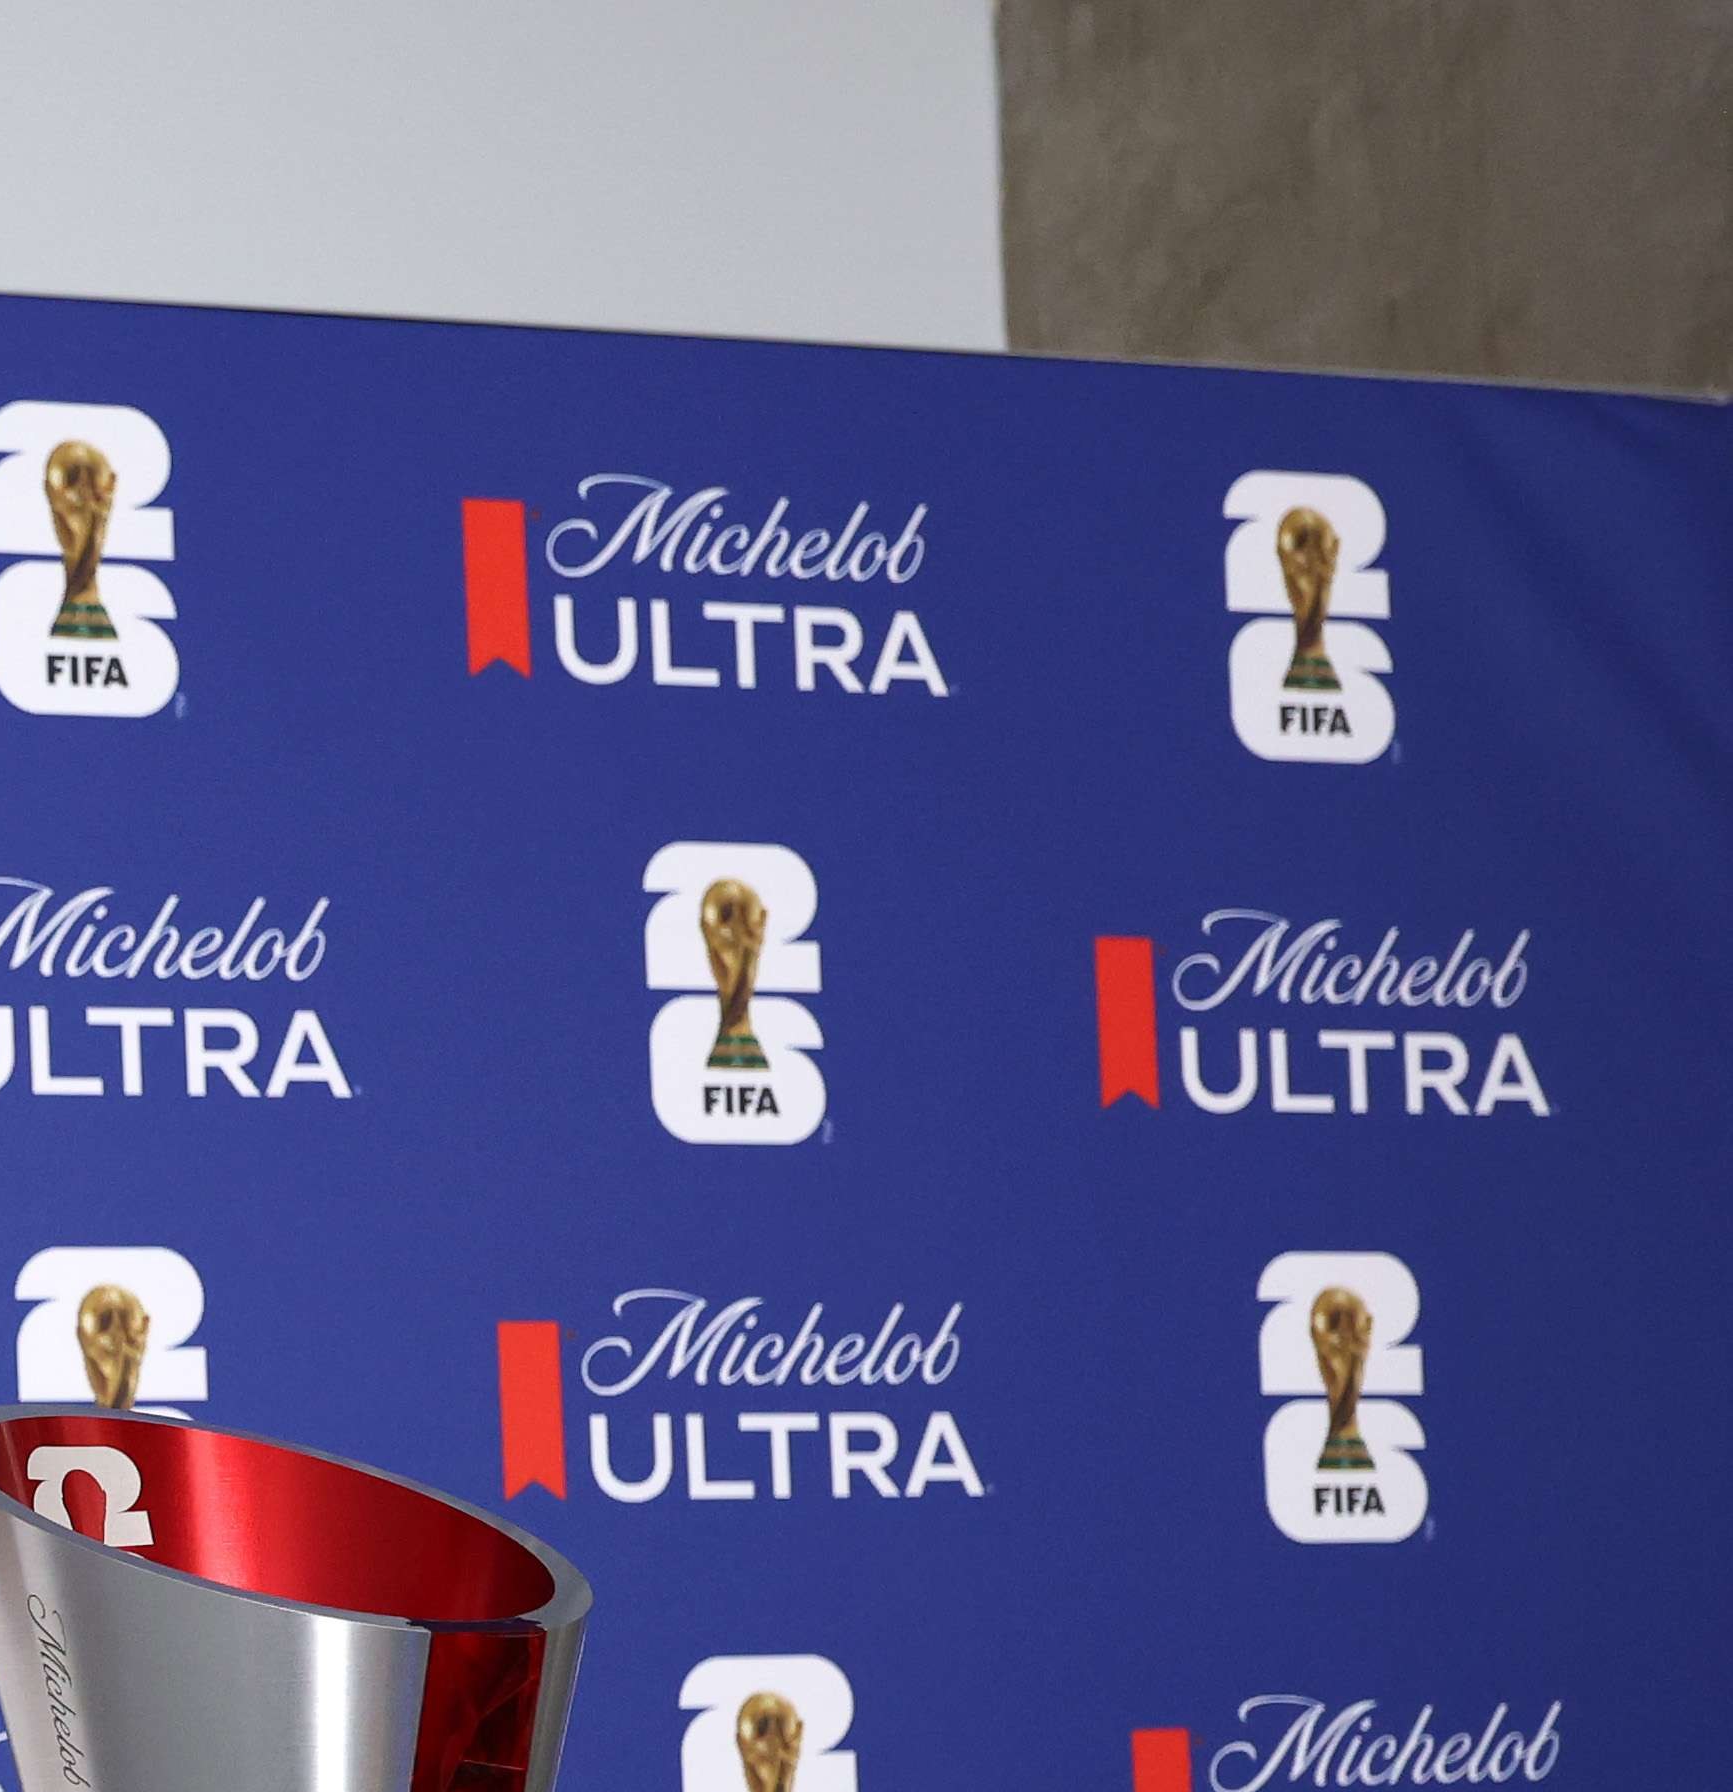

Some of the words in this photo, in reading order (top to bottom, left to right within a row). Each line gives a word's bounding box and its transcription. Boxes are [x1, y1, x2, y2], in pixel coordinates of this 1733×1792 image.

[545, 473, 928, 584] Michelob
[47, 655, 128, 687] FIFA
[553, 594, 949, 697] ULTRA
[1280, 705, 1351, 734] FIFA
[1172, 909, 1530, 1011] Michelob
[704, 1086, 779, 1115] FIFA
[1179, 1026, 1550, 1117] ULTRA
[581, 1288, 962, 1397] Michelob
[588, 1411, 985, 1504] ULTRA
[1314, 1487, 1384, 1514] FIFA
[27, 1594, 92, 1788] Michelob
